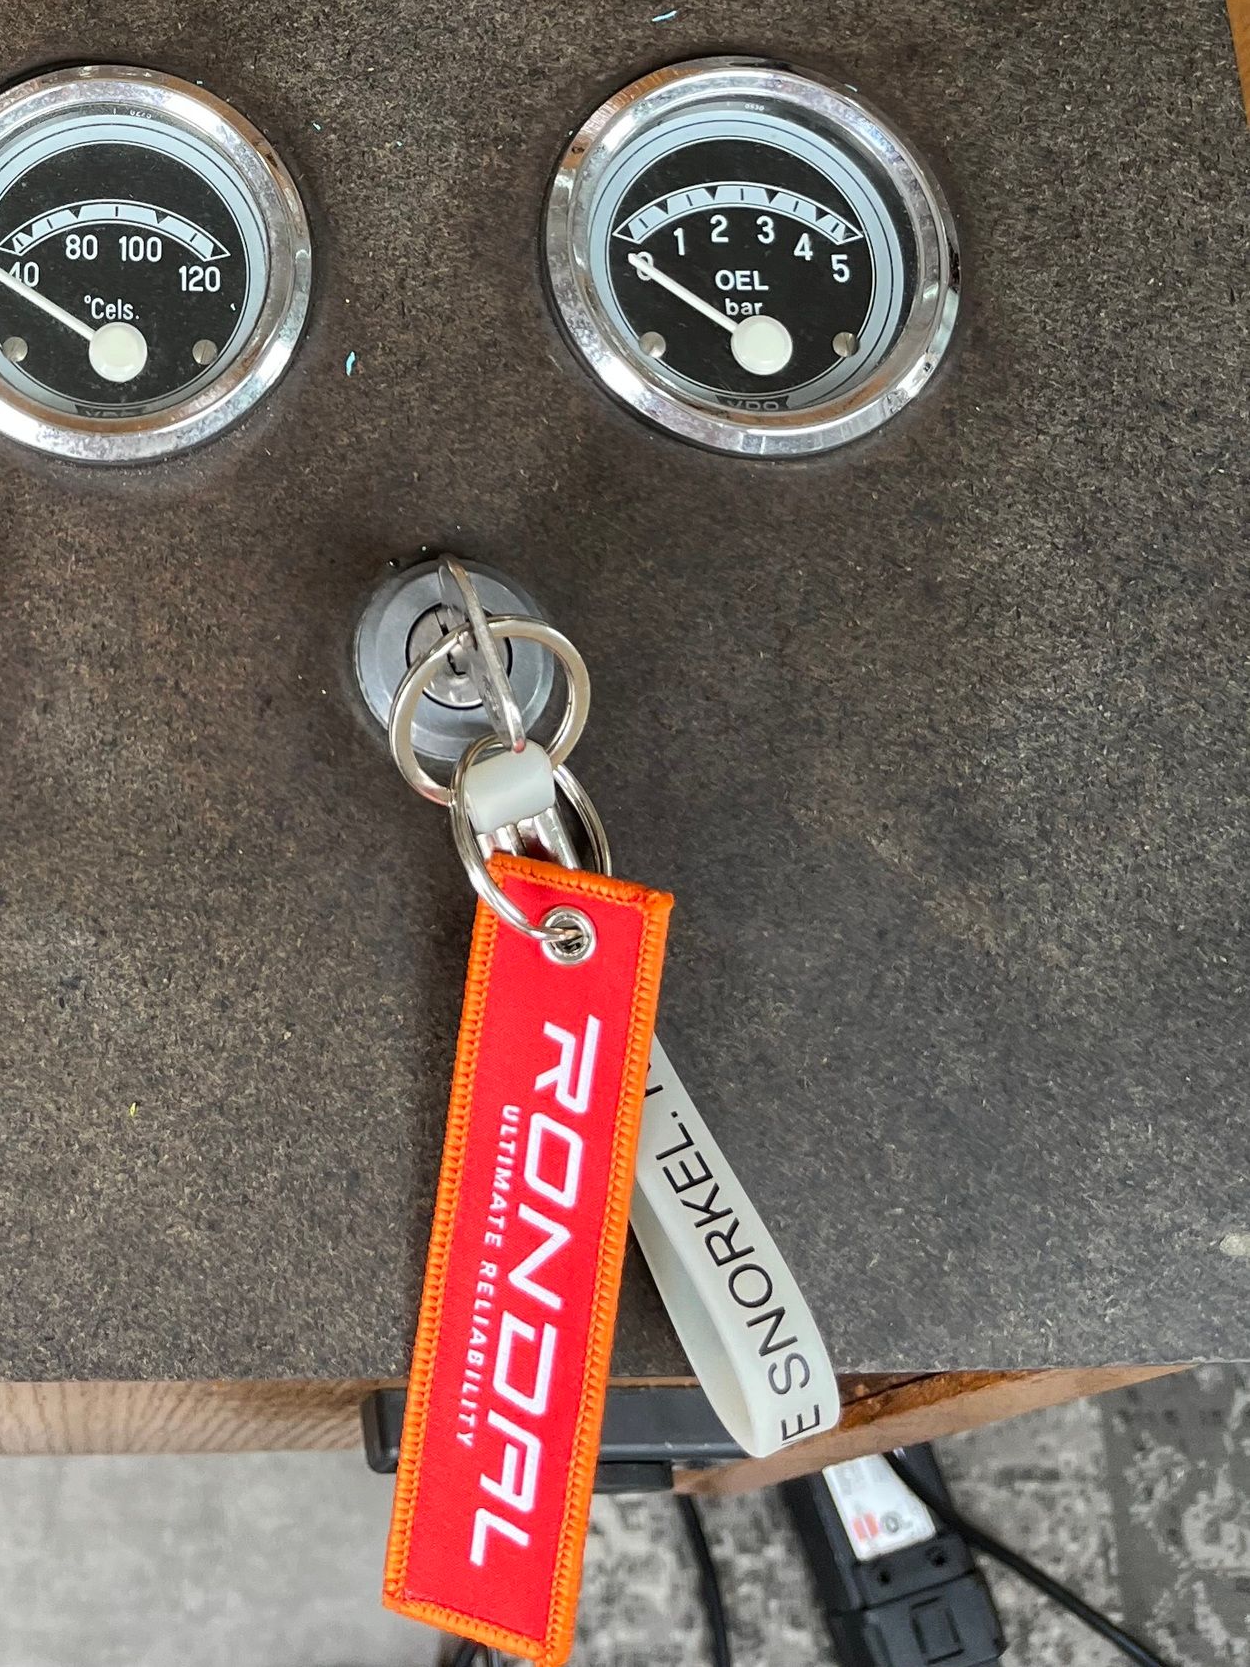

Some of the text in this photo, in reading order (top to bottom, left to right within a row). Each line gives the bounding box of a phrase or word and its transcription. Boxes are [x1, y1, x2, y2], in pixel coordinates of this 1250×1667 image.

[65, 235, 99, 261] 80
[118, 236, 162, 263] 100
[178, 266, 221, 293] 120
[672, 227, 686, 256] 1
[710, 214, 730, 243] 2
[756, 215, 776, 244] 3
[793, 232, 814, 261] 4
[830, 253, 851, 283] 5
[714, 269, 770, 292] OEL
[725, 298, 763, 316] bar
[455, 1103, 521, 1449] ULTIMATE RELIABILITY
[654, 1110, 811, 1396] SNORKEL.
[468, 1013, 601, 1568] RONDAL
